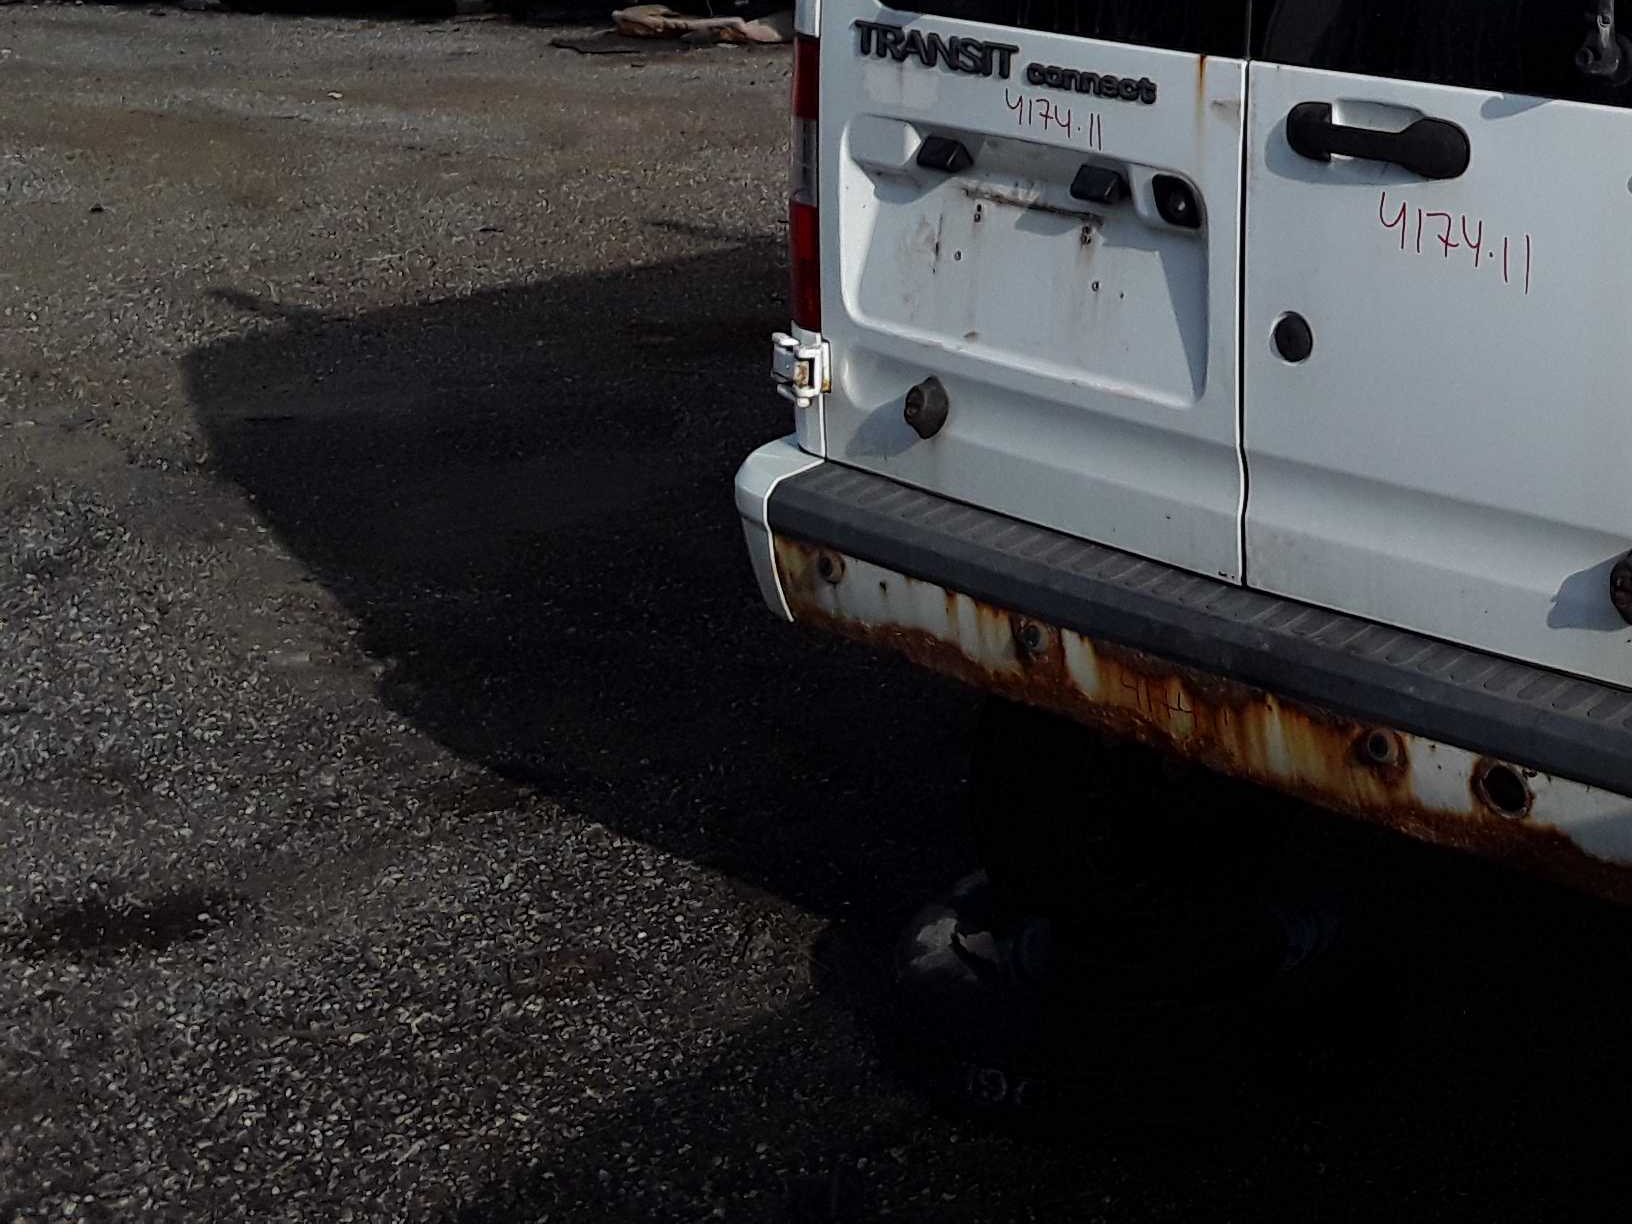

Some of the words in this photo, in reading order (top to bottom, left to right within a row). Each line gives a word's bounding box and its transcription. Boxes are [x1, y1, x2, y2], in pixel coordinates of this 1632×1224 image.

[853, 19, 1020, 80] TRANSIT
[1026, 62, 1158, 105] connect
[1379, 190, 1532, 295] 4174.11
